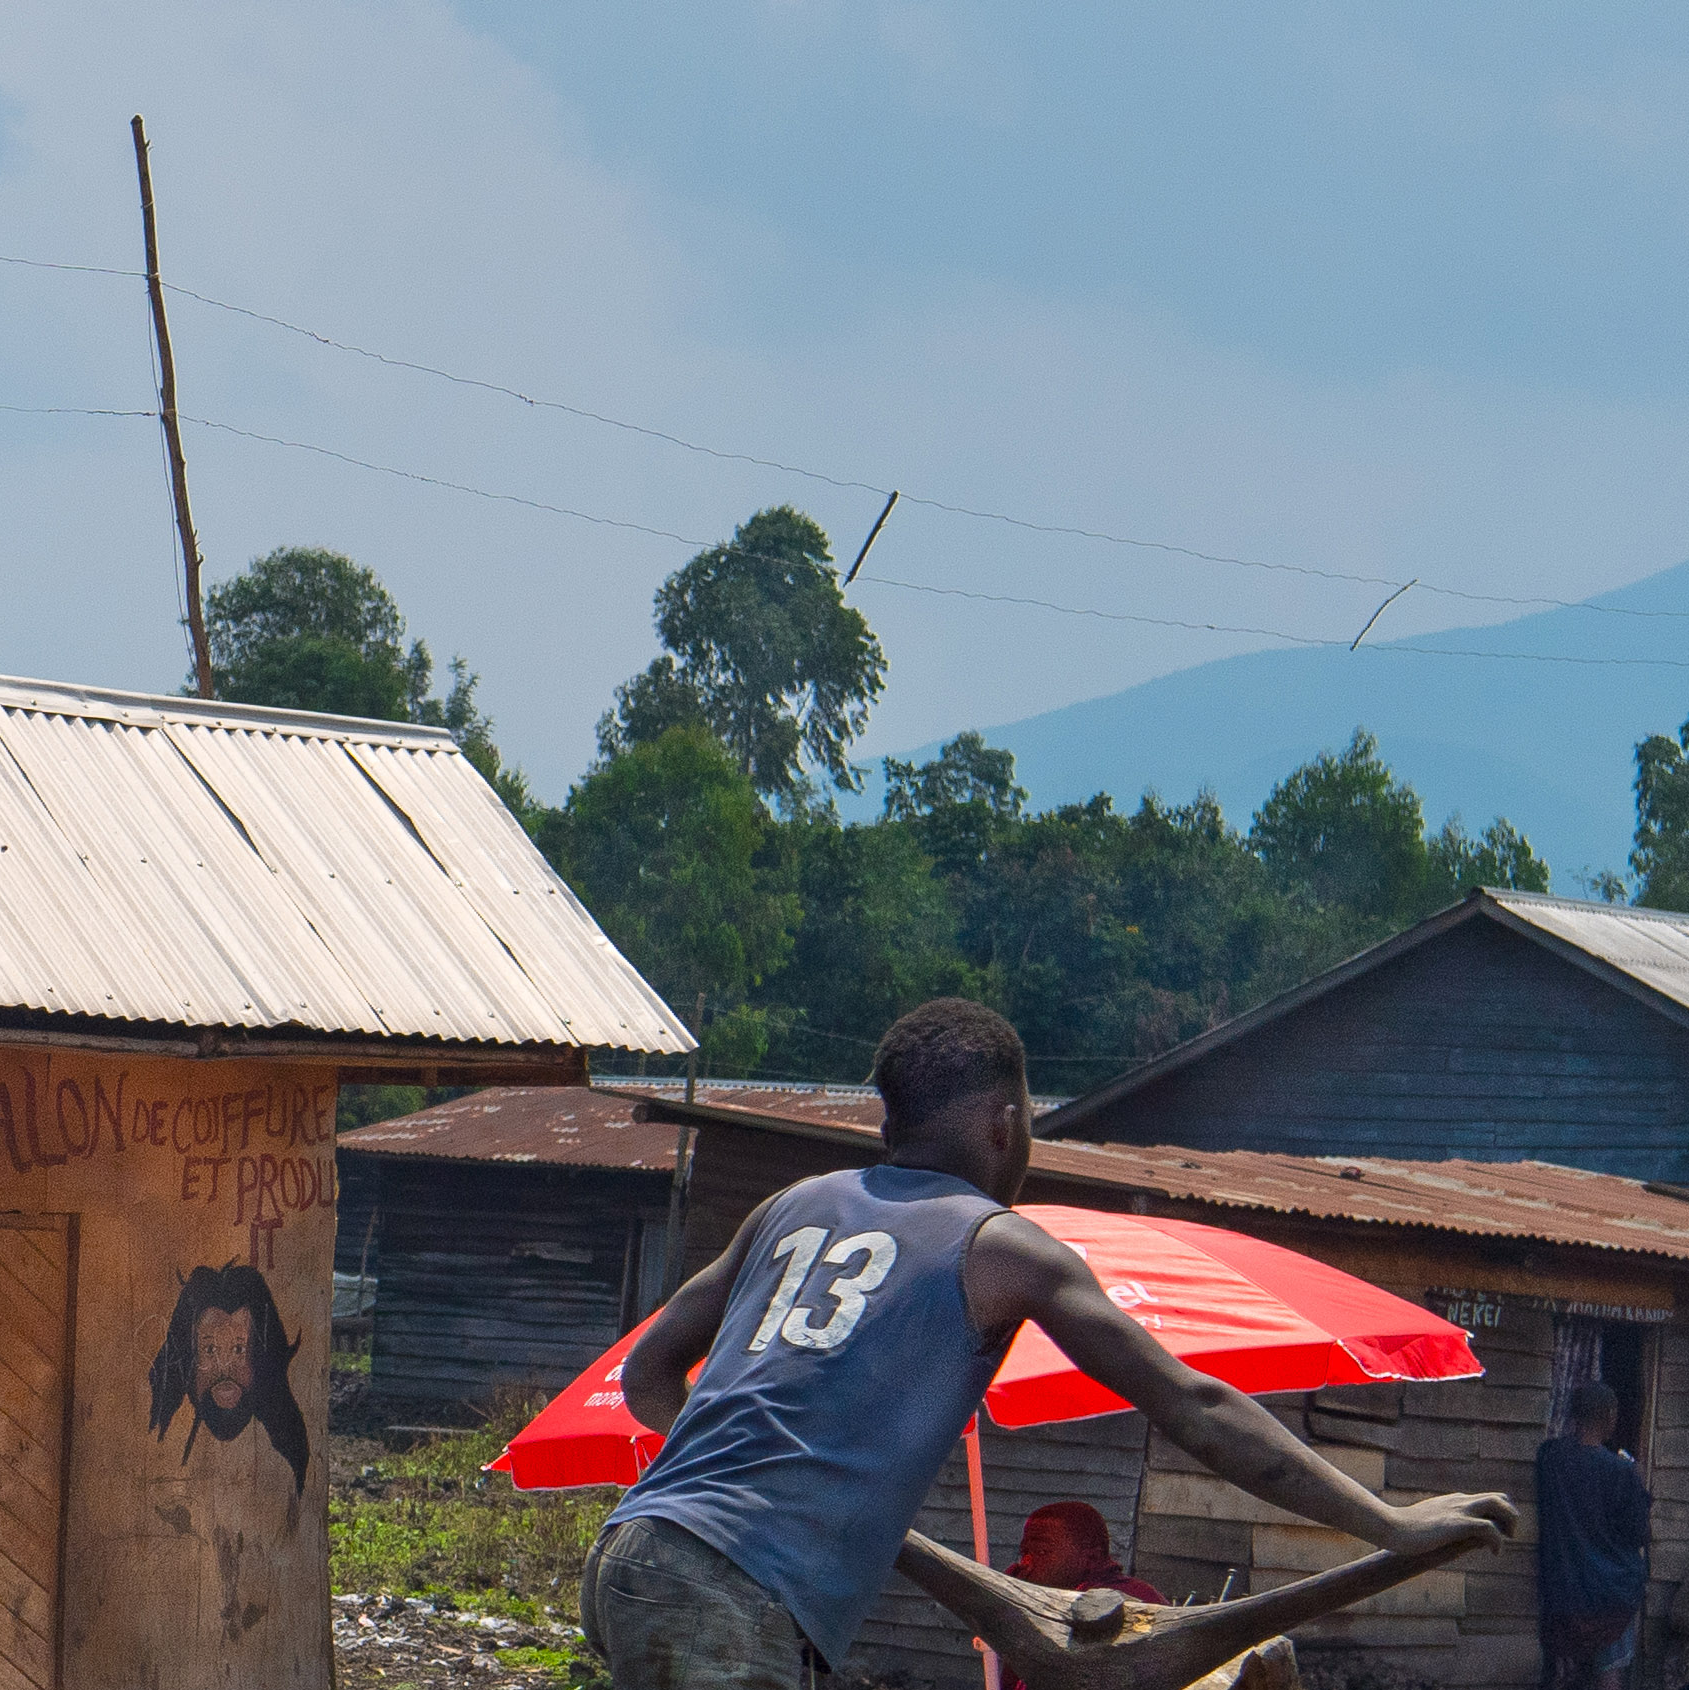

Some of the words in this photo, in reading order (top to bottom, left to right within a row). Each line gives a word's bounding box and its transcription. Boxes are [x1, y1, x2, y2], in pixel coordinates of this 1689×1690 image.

[132, 1098, 168, 1147] DE
[171, 1084, 333, 1154] COIFFURE
[182, 1157, 231, 1201] ET
[747, 1225, 898, 1352] 13
